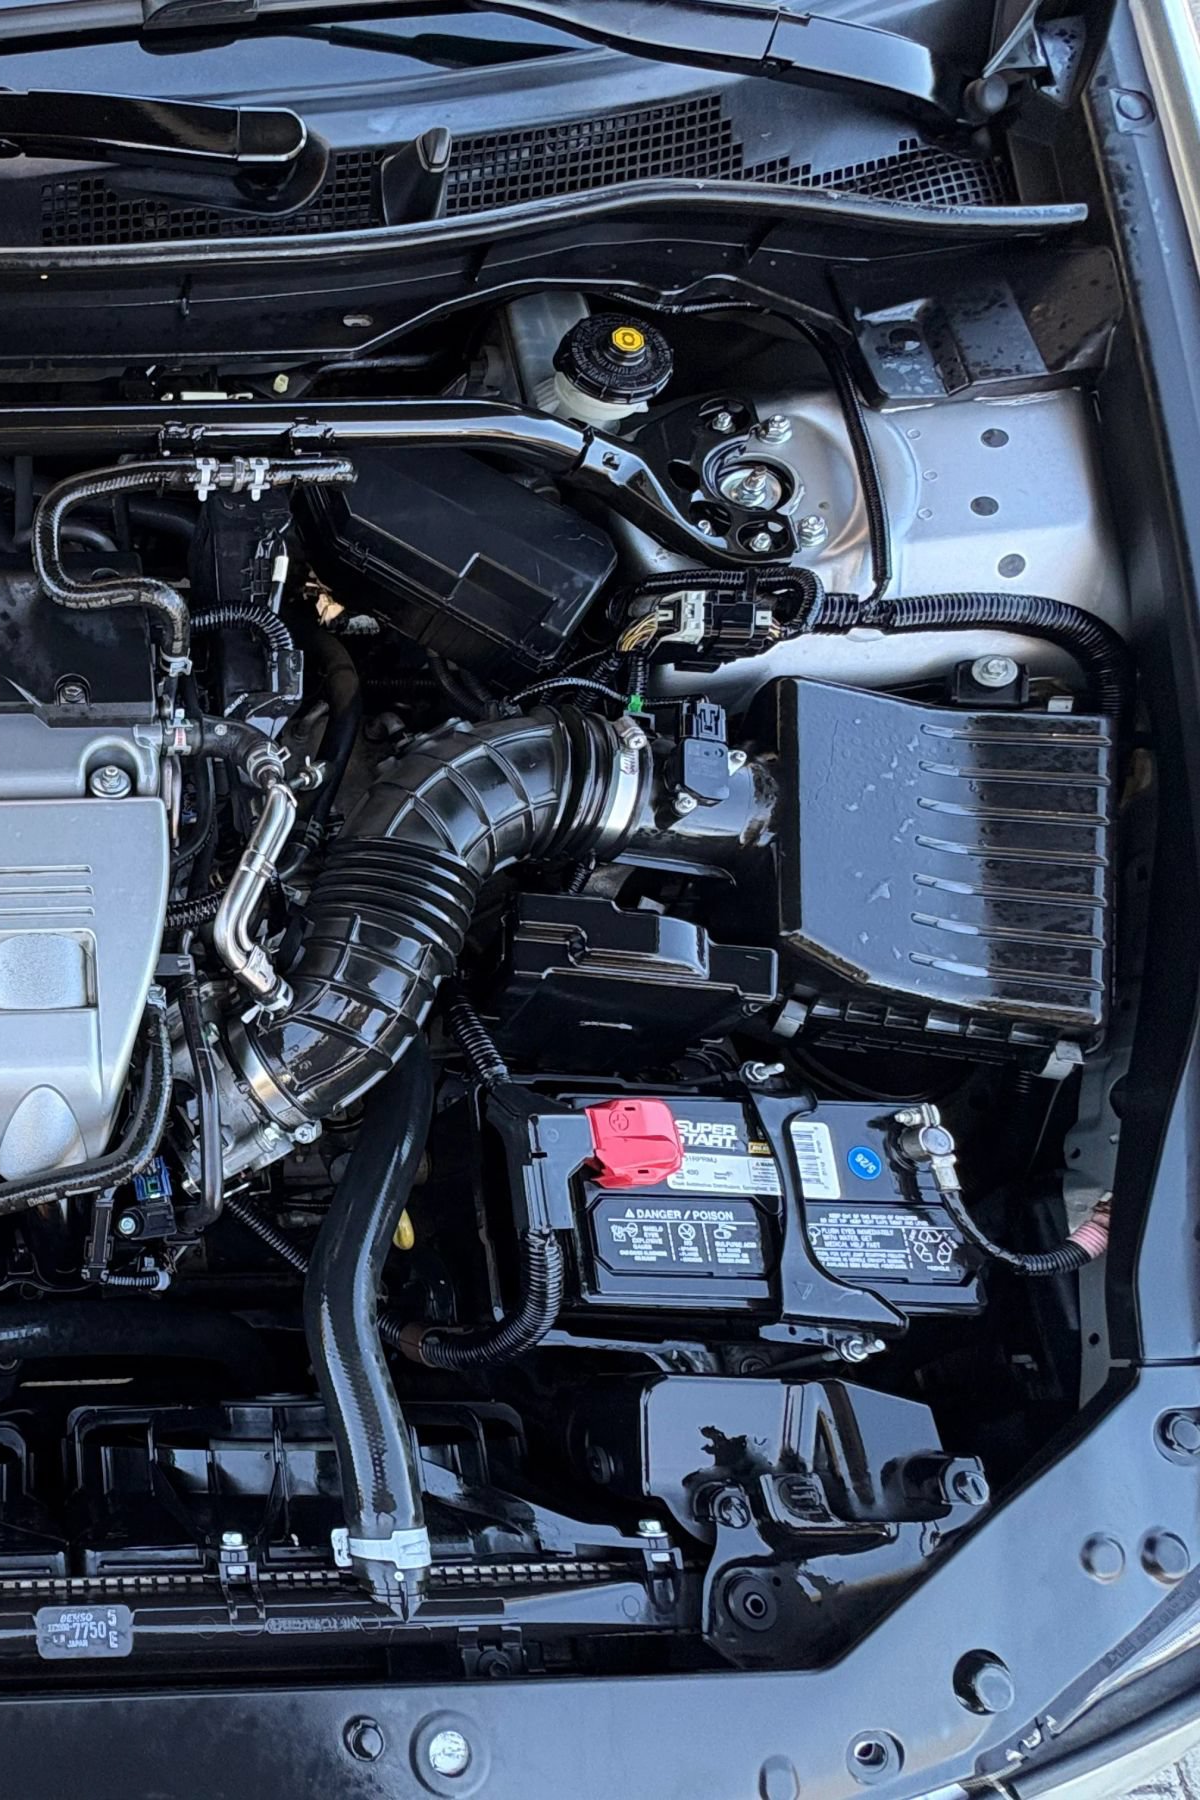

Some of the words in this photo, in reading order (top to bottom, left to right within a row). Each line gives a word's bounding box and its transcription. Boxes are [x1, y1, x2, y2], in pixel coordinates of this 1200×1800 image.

[674, 1120, 736, 1135] SUPER
[855, 1153, 877, 1174] 5/26
[636, 1208, 682, 1219] DANGER
[692, 1210, 734, 1221] POISON
[60, 1613, 93, 1623] DENSO
[67, 1640, 88, 1648] JAPAN
